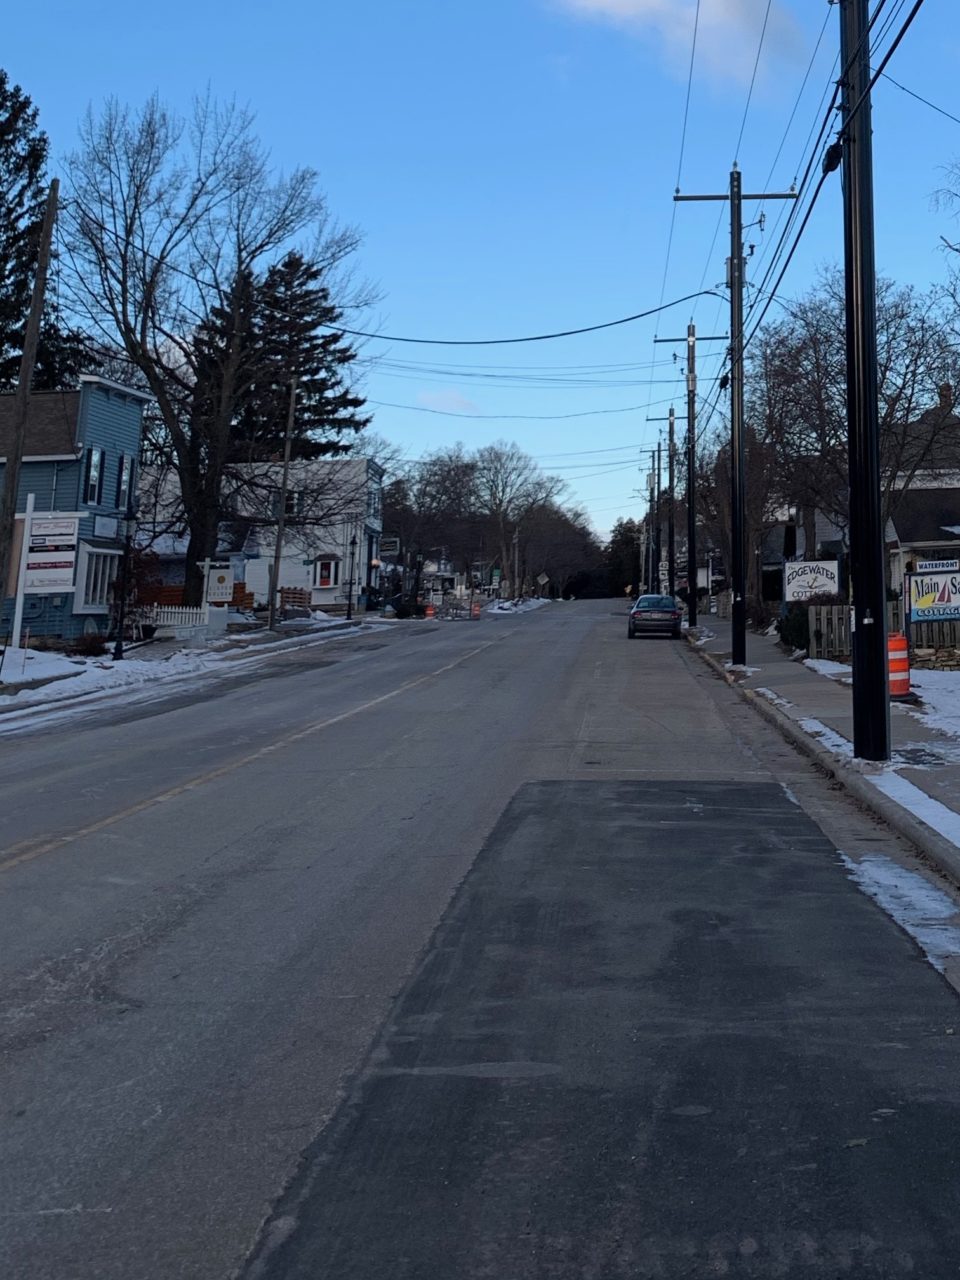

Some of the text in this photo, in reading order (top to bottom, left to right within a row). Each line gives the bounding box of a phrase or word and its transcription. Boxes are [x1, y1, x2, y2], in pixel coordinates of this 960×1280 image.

[787, 564, 836, 586] EDGEWATER
[918, 561, 958, 570] WATERFRONT
[914, 578, 940, 602] Main
